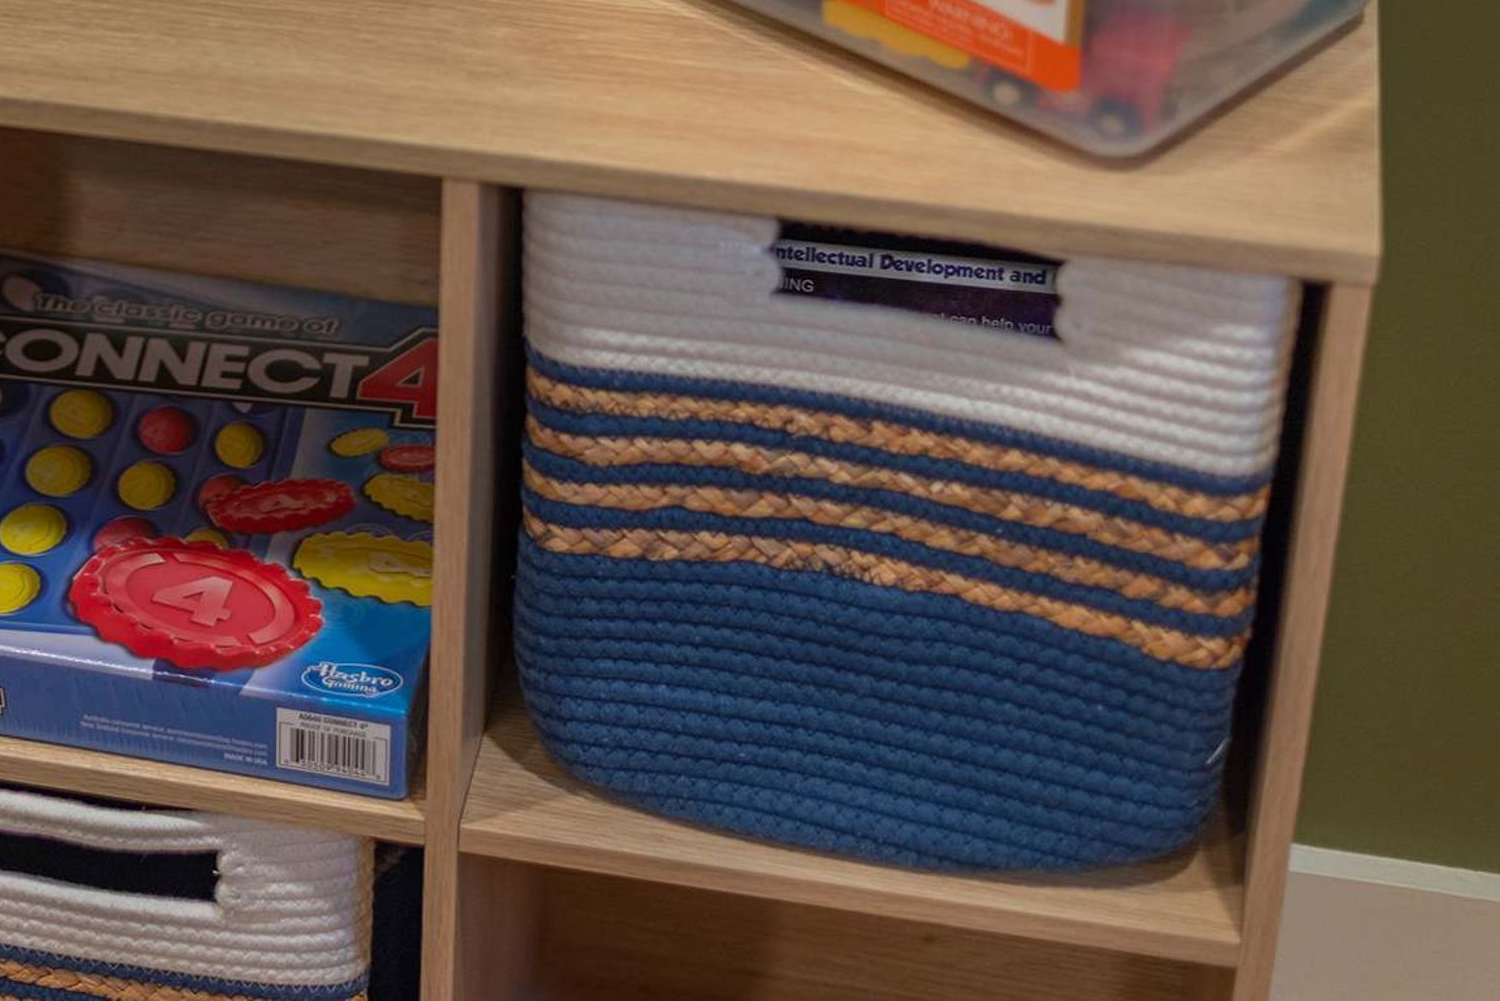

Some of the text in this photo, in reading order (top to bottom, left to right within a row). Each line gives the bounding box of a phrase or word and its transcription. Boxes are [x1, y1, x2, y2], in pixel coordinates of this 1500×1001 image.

[774, 245, 874, 269] ntellectual
[880, 253, 1005, 280] Development
[1009, 269, 1048, 286] and
[94, 299, 202, 324] classic
[205, 310, 299, 332] game
[302, 317, 340, 336] of
[981, 314, 1014, 331] help
[359, 338, 438, 419] 4
[319, 661, 394, 687] Hasbro
